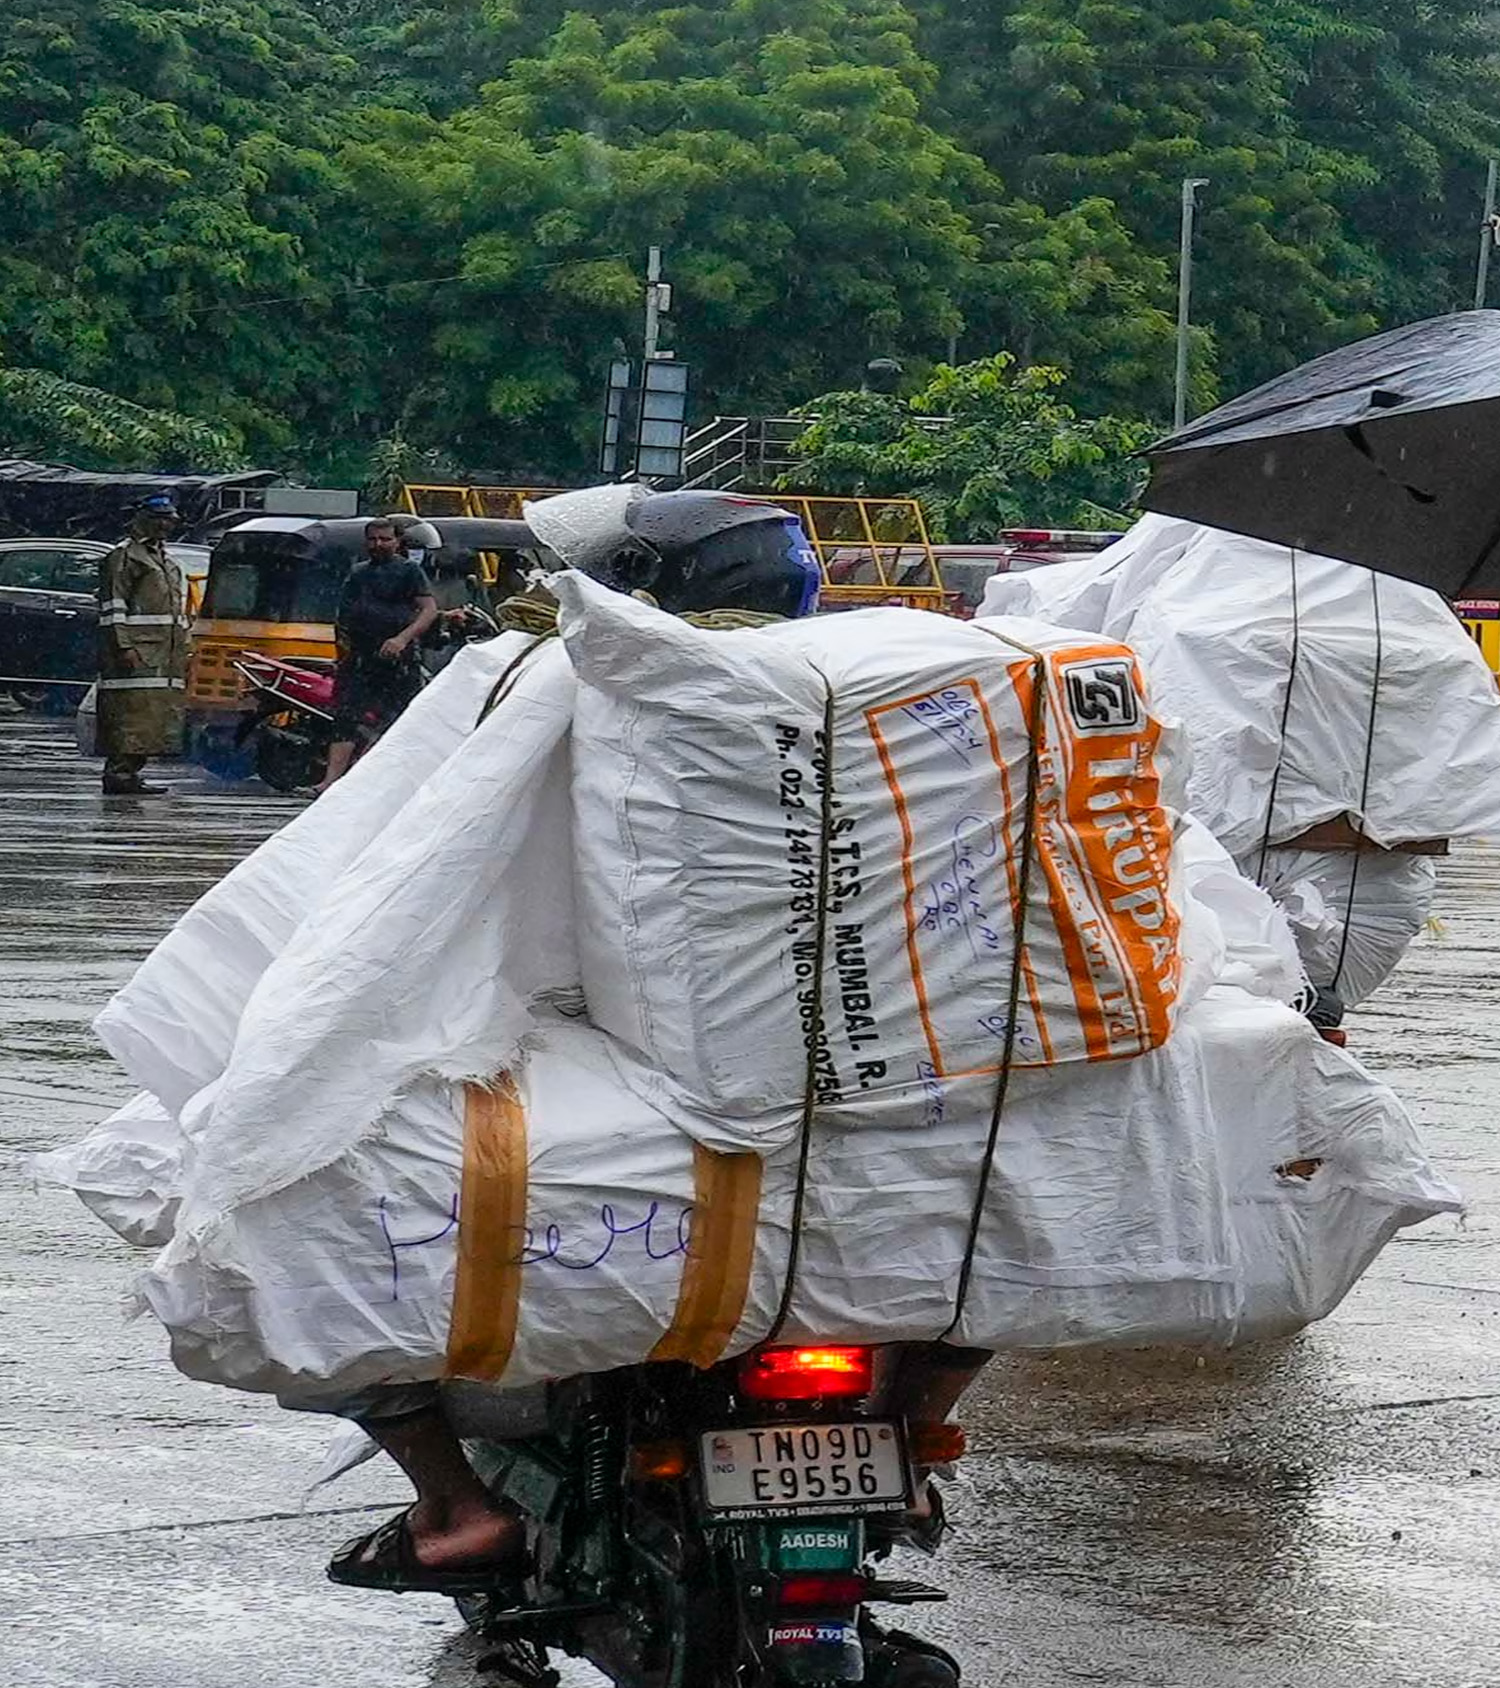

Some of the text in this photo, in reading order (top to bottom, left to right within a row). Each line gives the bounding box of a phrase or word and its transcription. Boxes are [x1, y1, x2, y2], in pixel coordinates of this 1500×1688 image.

[775, 724, 800, 759] Ph.
[781, 769, 804, 808] 022
[747, 1427, 871, 1463] TN09D
[752, 1463, 878, 1502] E9556
[780, 1533, 848, 1550] AADESH
